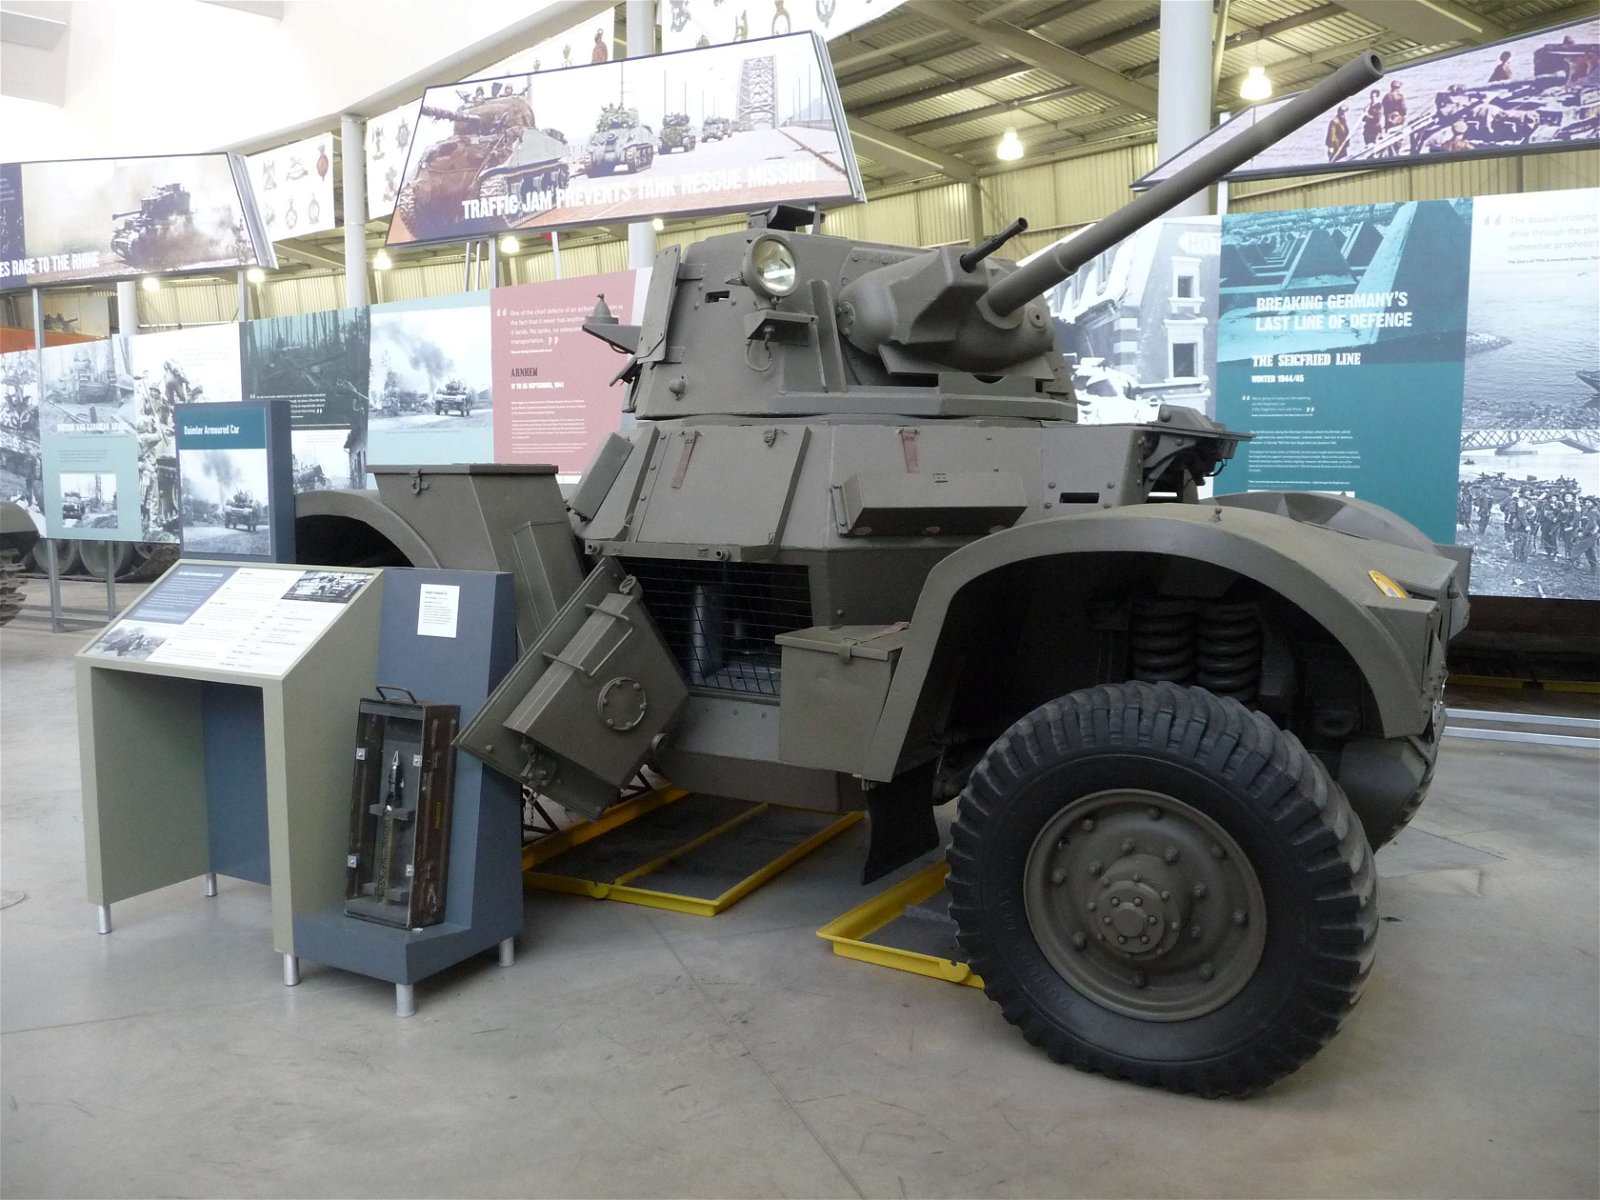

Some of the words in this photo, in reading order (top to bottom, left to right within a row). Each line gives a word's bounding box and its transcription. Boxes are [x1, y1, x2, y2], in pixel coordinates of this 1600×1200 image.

[462, 195, 518, 219] TRAFFIC
[522, 190, 552, 212] JAM
[556, 180, 631, 209] PREVENTS
[638, 176, 676, 200] TANK
[682, 168, 743, 195] RESCUE
[749, 160, 816, 188] MISSION
[1561, 213, 1597, 223] crossing
[1532, 228, 1565, 238] through
[1567, 227, 1581, 235] the
[0, 261, 10, 277] ES
[11, 258, 36, 275] RACE
[37, 256, 50, 273] TO
[51, 254, 70, 271] THE
[72, 251, 100, 270] RHINE
[1256, 295, 1323, 312] BREAKING
[1327, 291, 1408, 309] GERMANY'S
[1255, 316, 1291, 332] LAST
[1294, 315, 1323, 331] LINE
[1328, 314, 1346, 329] OF
[1351, 312, 1413, 329] DEFENCE
[1251, 354, 1274, 367] THE
[1335, 352, 1361, 366] LINE
[511, 367, 538, 377] ARNHEM
[1251, 375, 1275, 383] WINTER
[1277, 374, 1304, 383] 1944/45
[184, 425, 203, 435] Daimler
[204, 424, 230, 434] Armoured
[230, 424, 240, 434] Car
